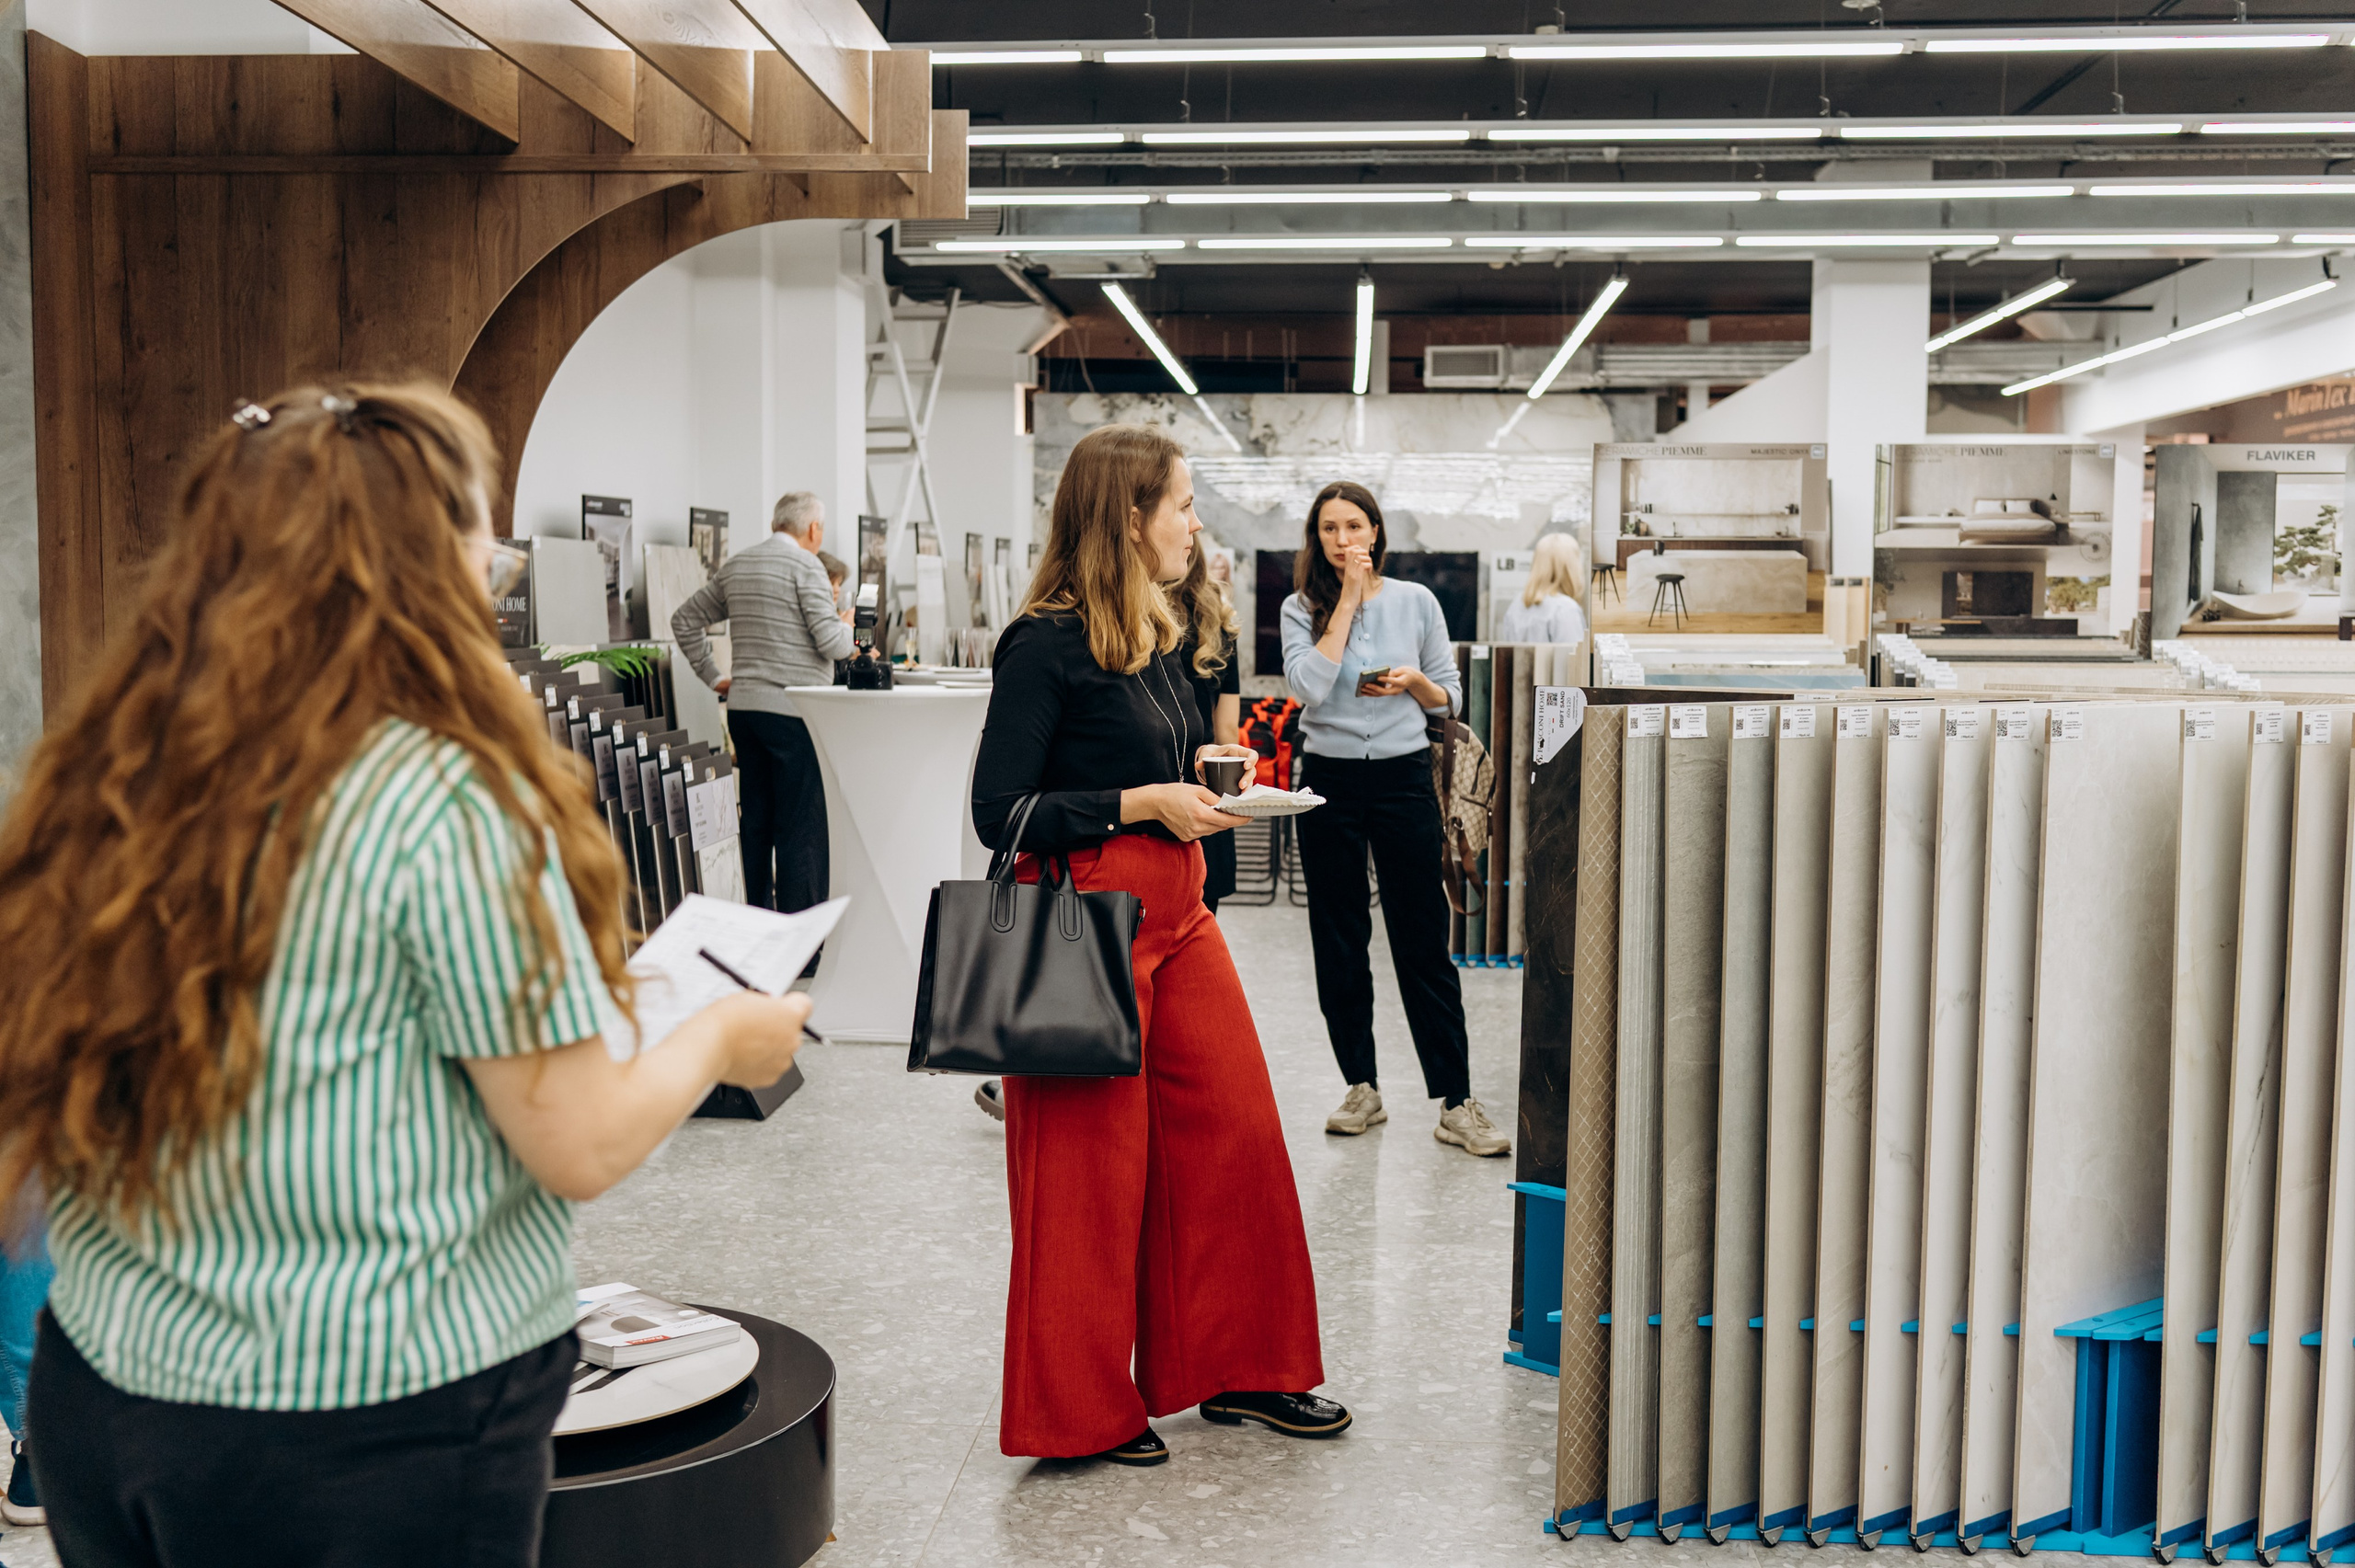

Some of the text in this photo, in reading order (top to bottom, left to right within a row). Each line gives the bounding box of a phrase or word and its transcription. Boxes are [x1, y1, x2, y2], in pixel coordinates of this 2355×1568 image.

[1661, 446, 1707, 455] PIEMME
[1960, 448, 2007, 456] PIEMME
[2246, 450, 2316, 461] FLAVIKER
[1497, 557, 1515, 570] LB
[506, 597, 526, 612] HOME
